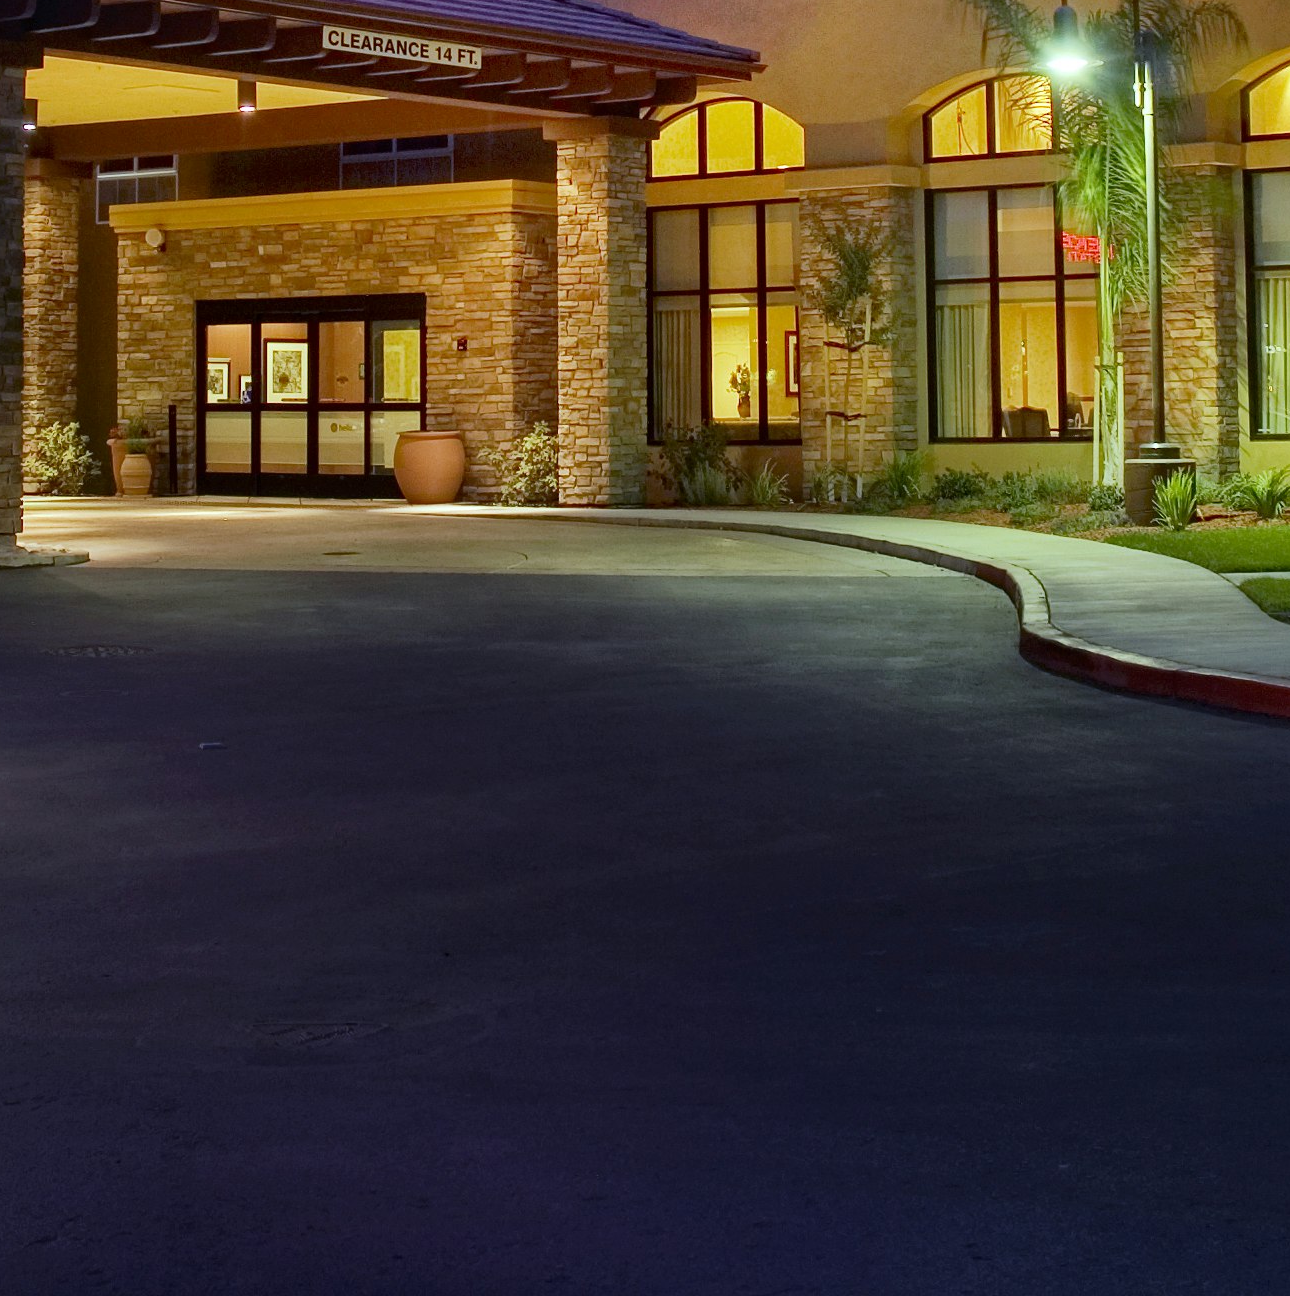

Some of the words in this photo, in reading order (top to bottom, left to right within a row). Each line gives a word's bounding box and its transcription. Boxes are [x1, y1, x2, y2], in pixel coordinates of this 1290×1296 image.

[327, 30, 430, 58] CLEARANCE
[435, 46, 453, 62] 14
[457, 48, 479, 66] FT.
